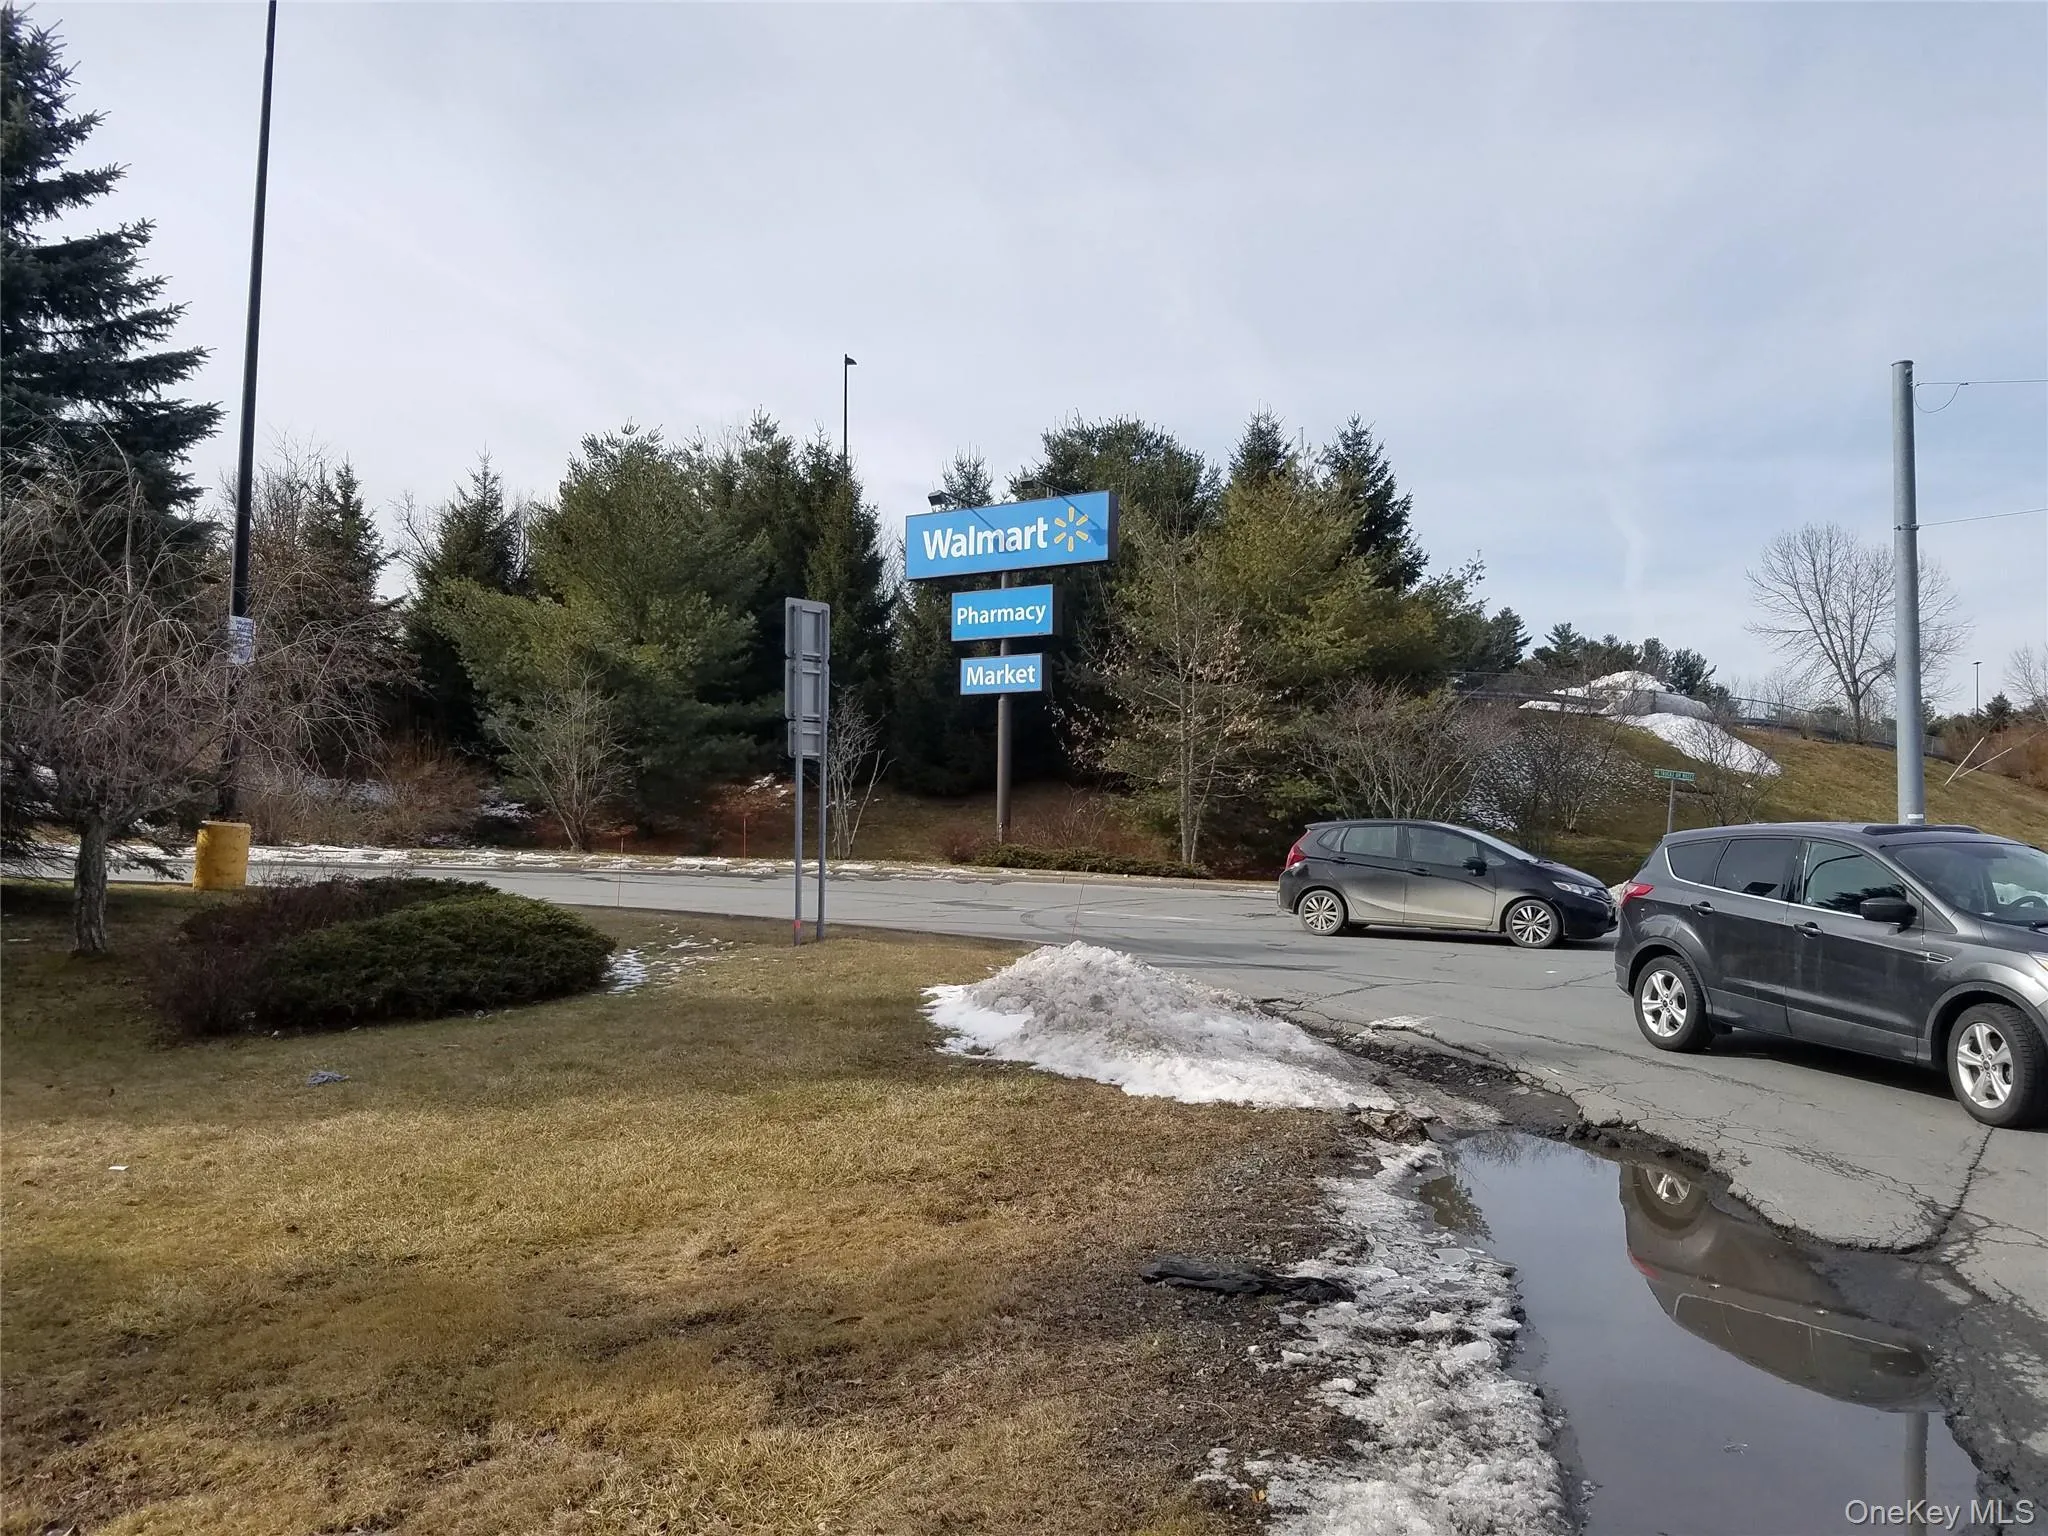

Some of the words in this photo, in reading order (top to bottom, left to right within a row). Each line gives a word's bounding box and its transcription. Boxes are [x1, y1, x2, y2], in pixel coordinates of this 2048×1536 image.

[923, 517, 1048, 560] Walmart
[957, 604, 1047, 625] Pharmacy
[966, 664, 1036, 687] Market
